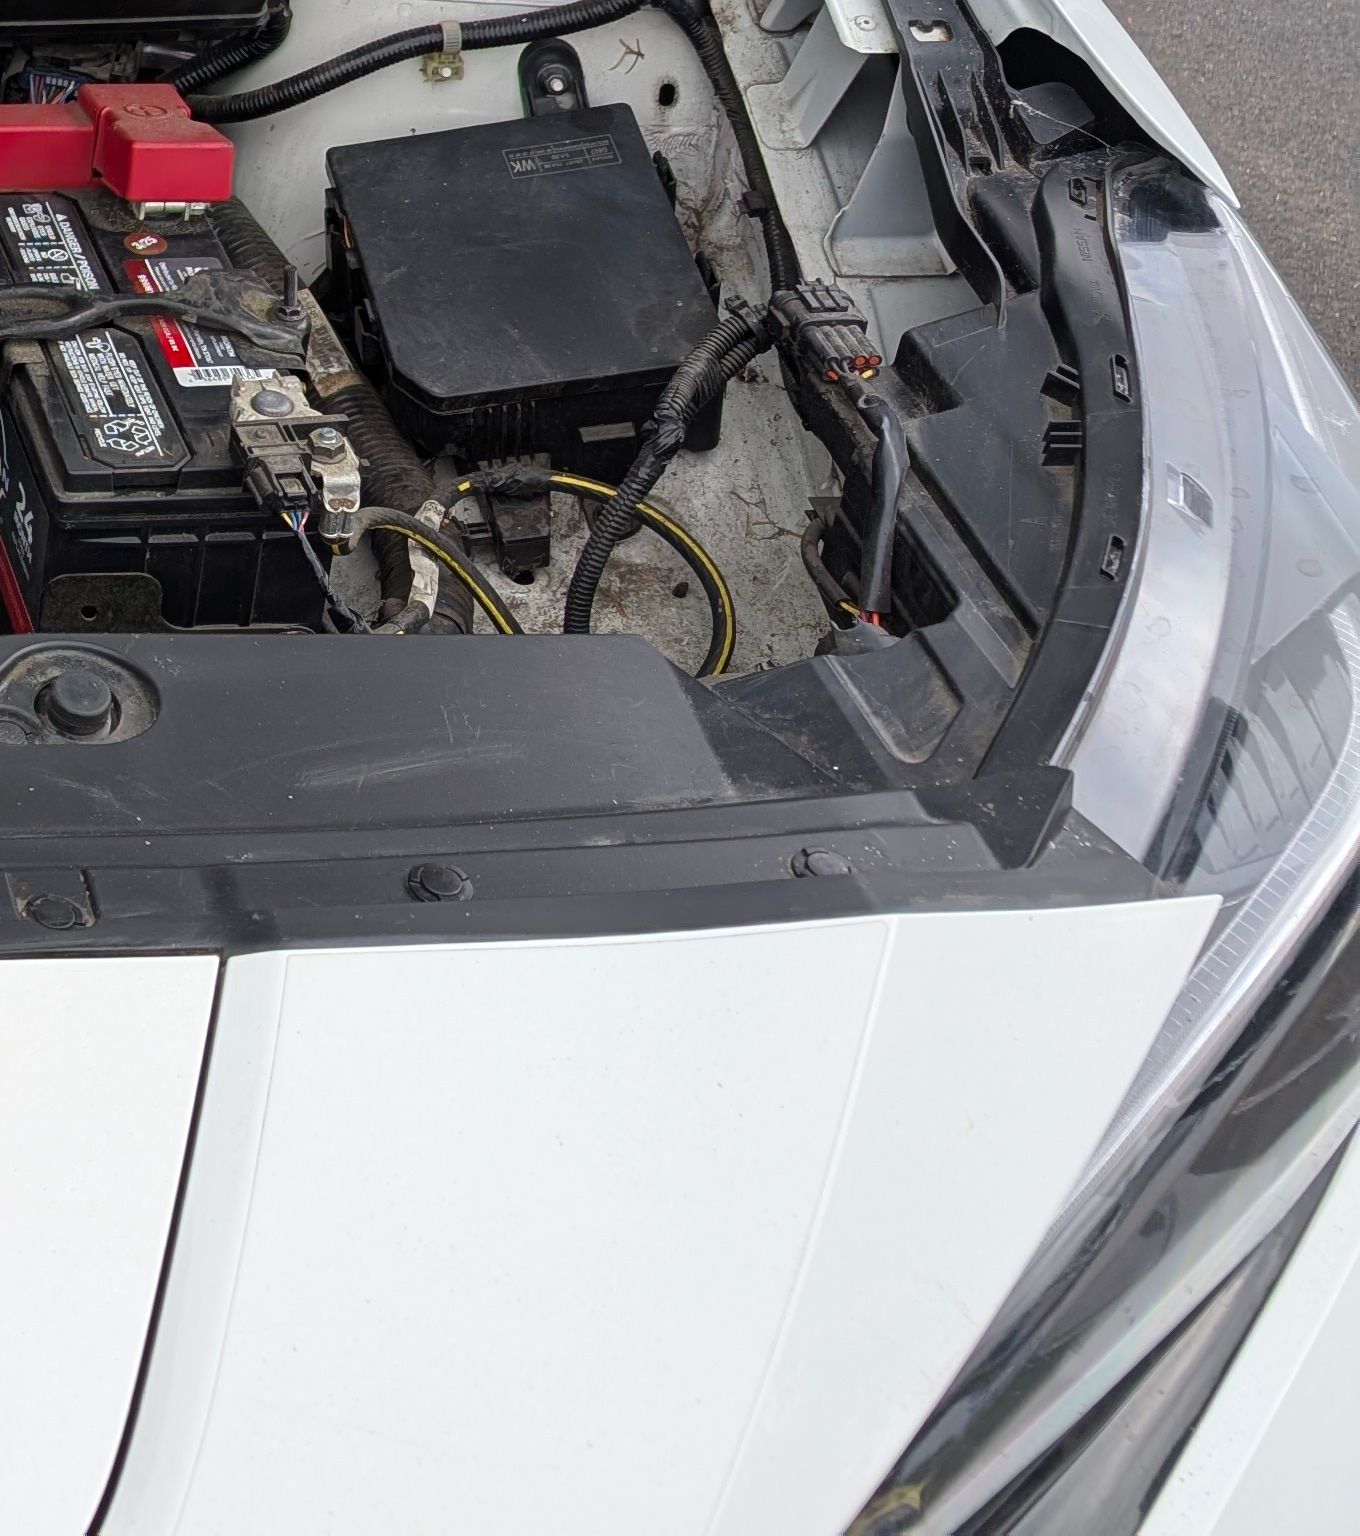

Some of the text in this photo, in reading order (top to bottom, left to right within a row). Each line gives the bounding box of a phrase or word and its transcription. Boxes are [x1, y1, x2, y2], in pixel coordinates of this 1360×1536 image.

[58, 221, 82, 252] DANGER
[76, 259, 99, 289] POISON
[104, 352, 117, 366] FLUSH
[110, 367, 122, 378] EYES
[108, 381, 119, 390] GET
